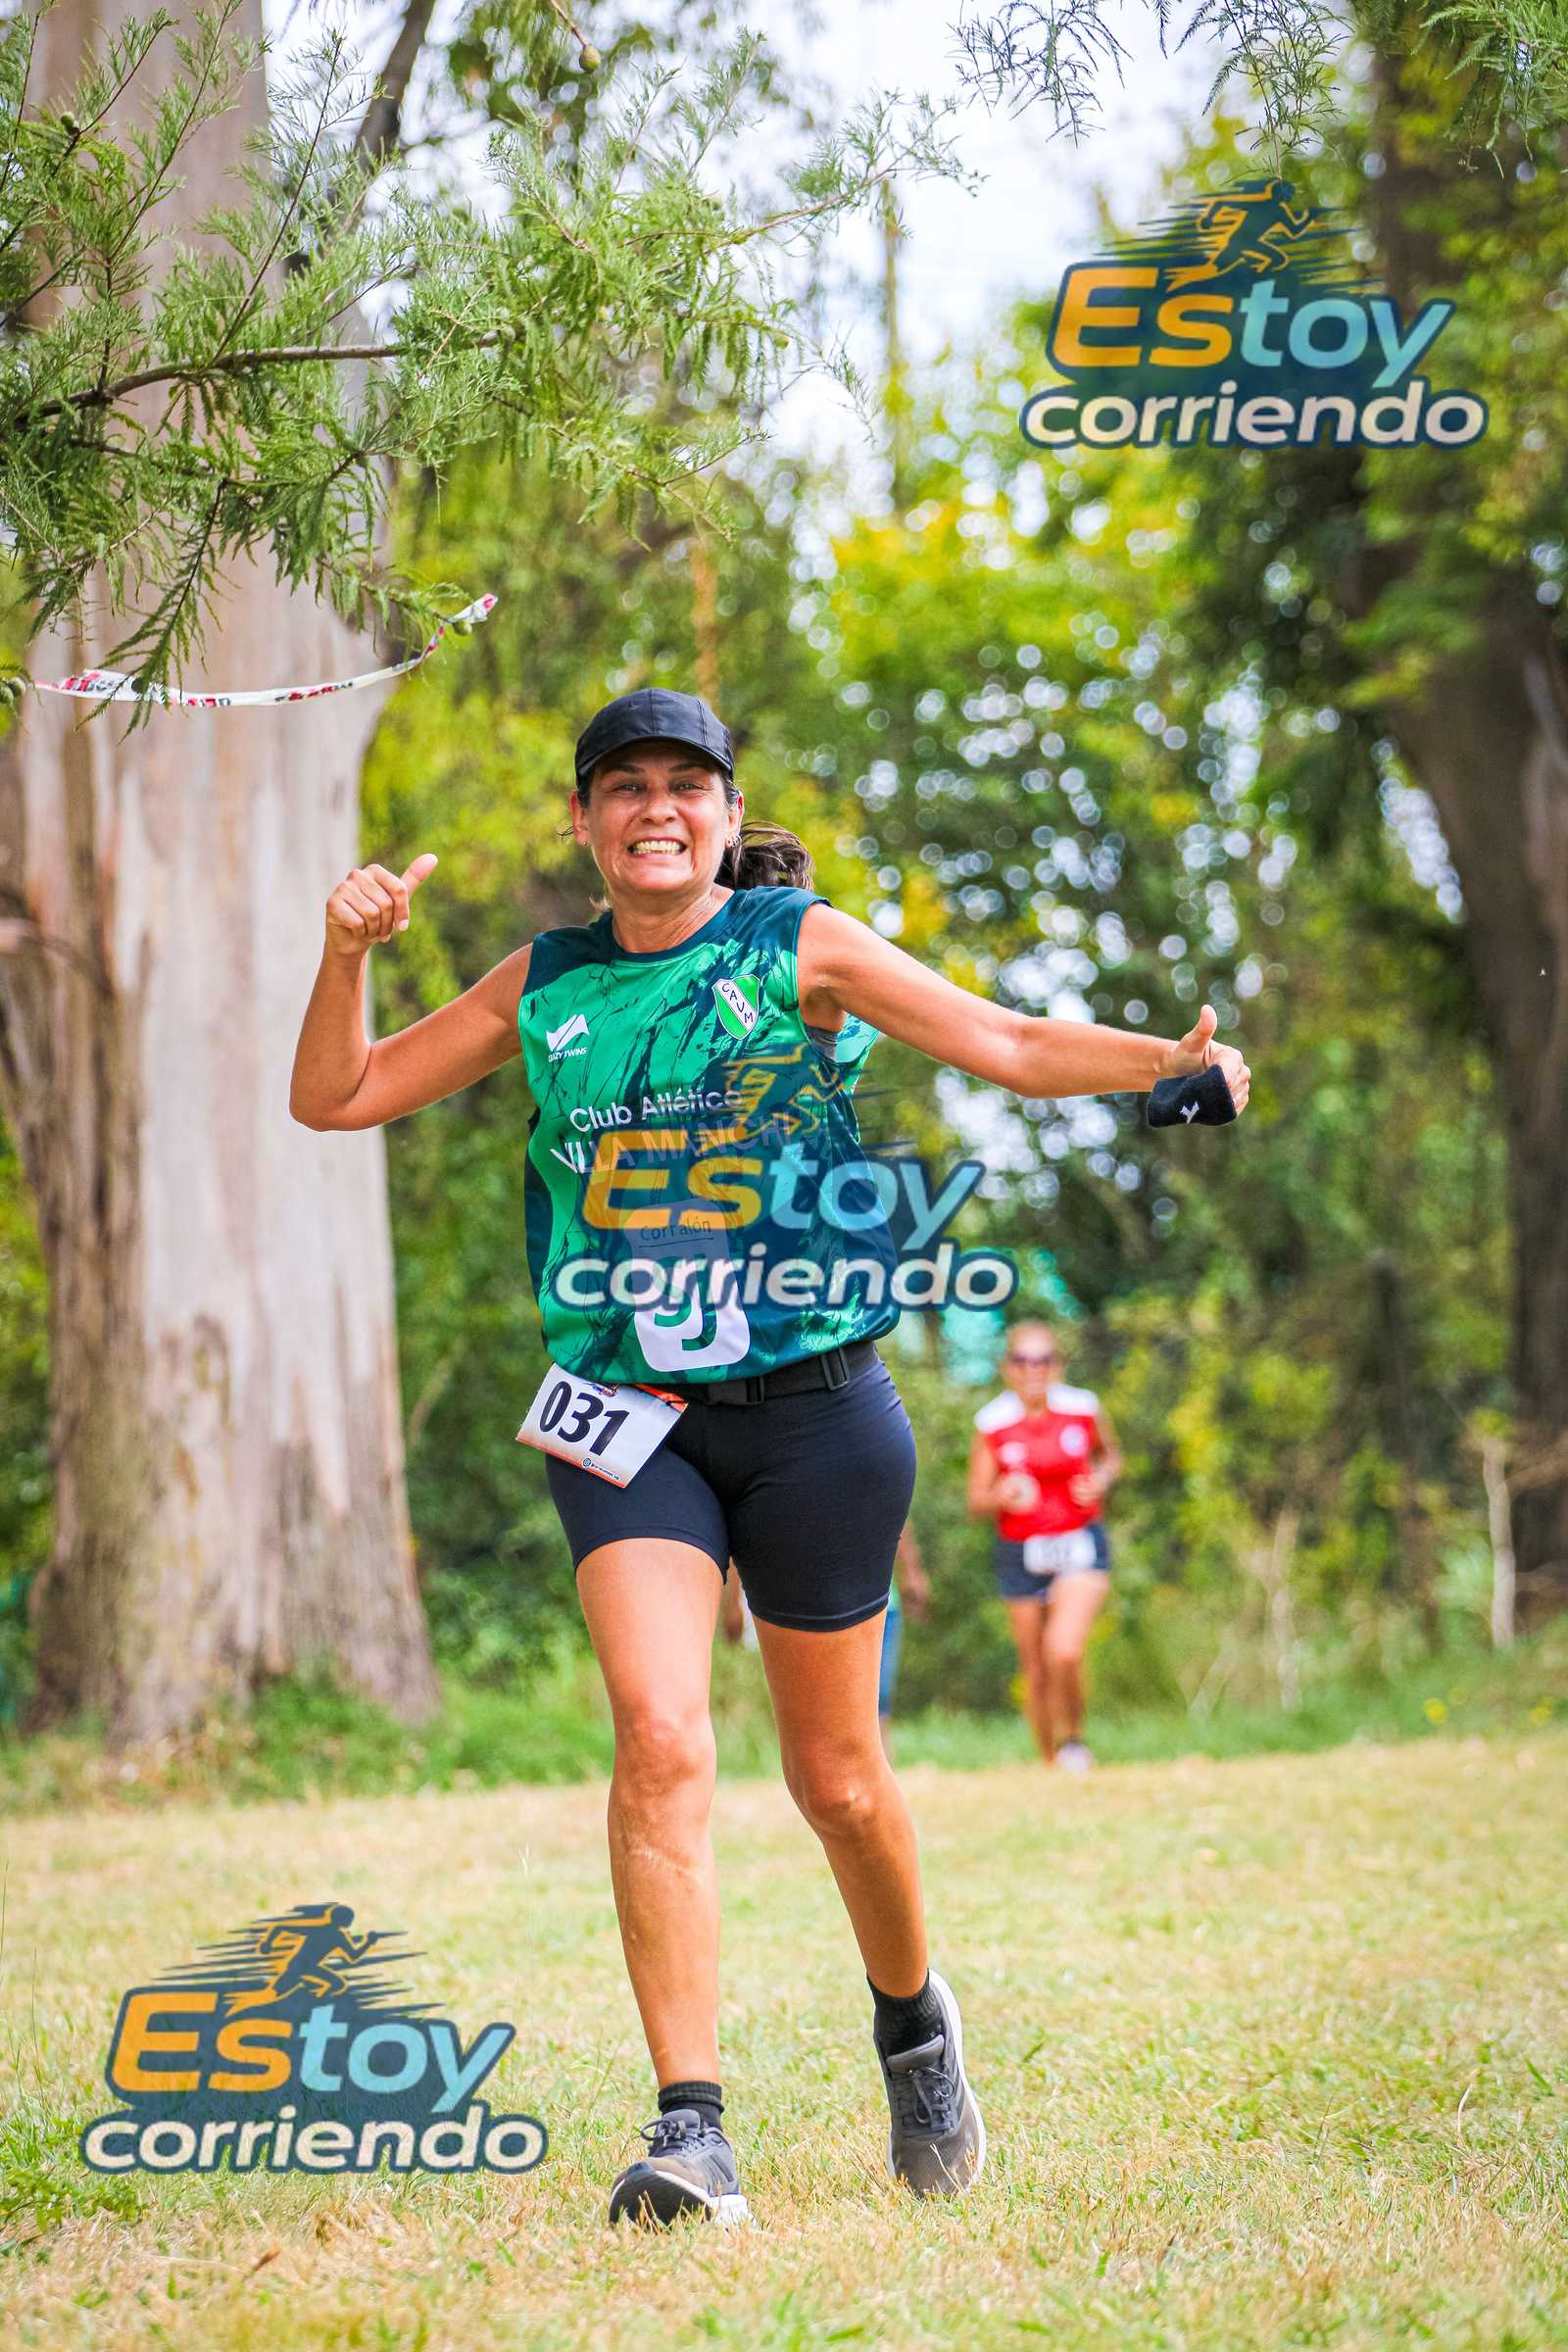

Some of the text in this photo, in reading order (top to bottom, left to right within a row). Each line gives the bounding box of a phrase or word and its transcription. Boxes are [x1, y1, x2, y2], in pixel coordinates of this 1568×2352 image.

[721, 982, 754, 1023] CAVM
[569, 1088, 743, 1133] Club Atlético
[539, 1380, 630, 1456] 031
